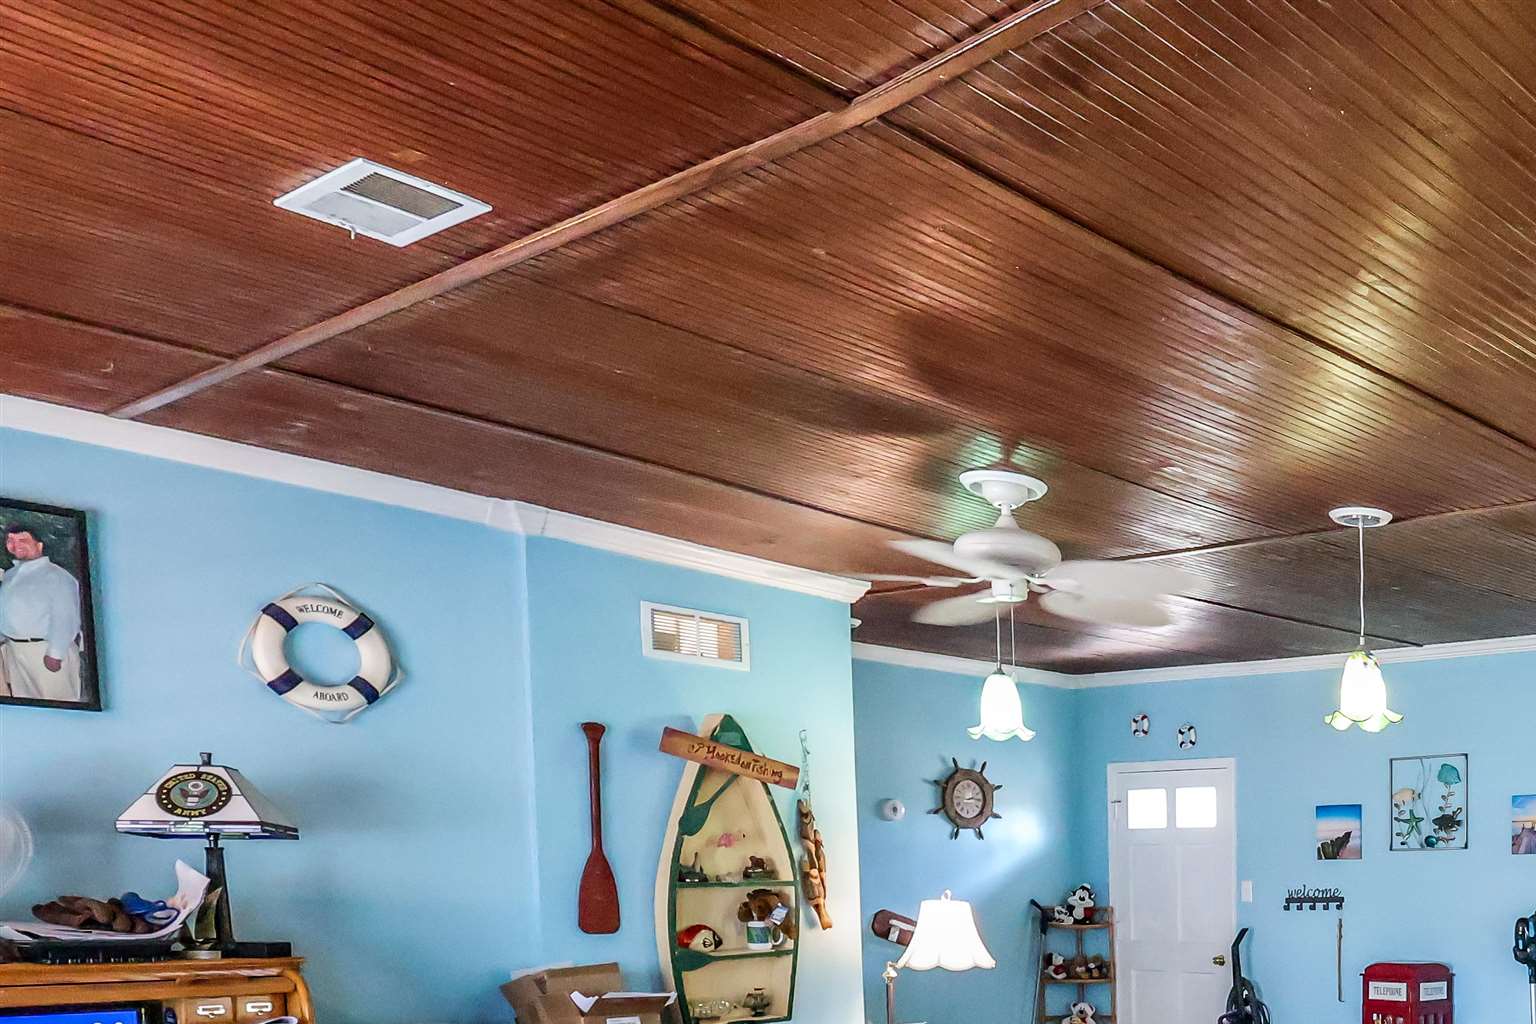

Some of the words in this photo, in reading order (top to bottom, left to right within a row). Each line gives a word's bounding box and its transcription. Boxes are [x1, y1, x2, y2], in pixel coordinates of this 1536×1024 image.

[296, 604, 344, 619] WELCOME
[313, 691, 349, 702] ABOARD
[174, 807, 207, 816] ARMY
[1288, 884, 1342, 898] welcome
[1373, 986, 1402, 997] TELEPHONE
